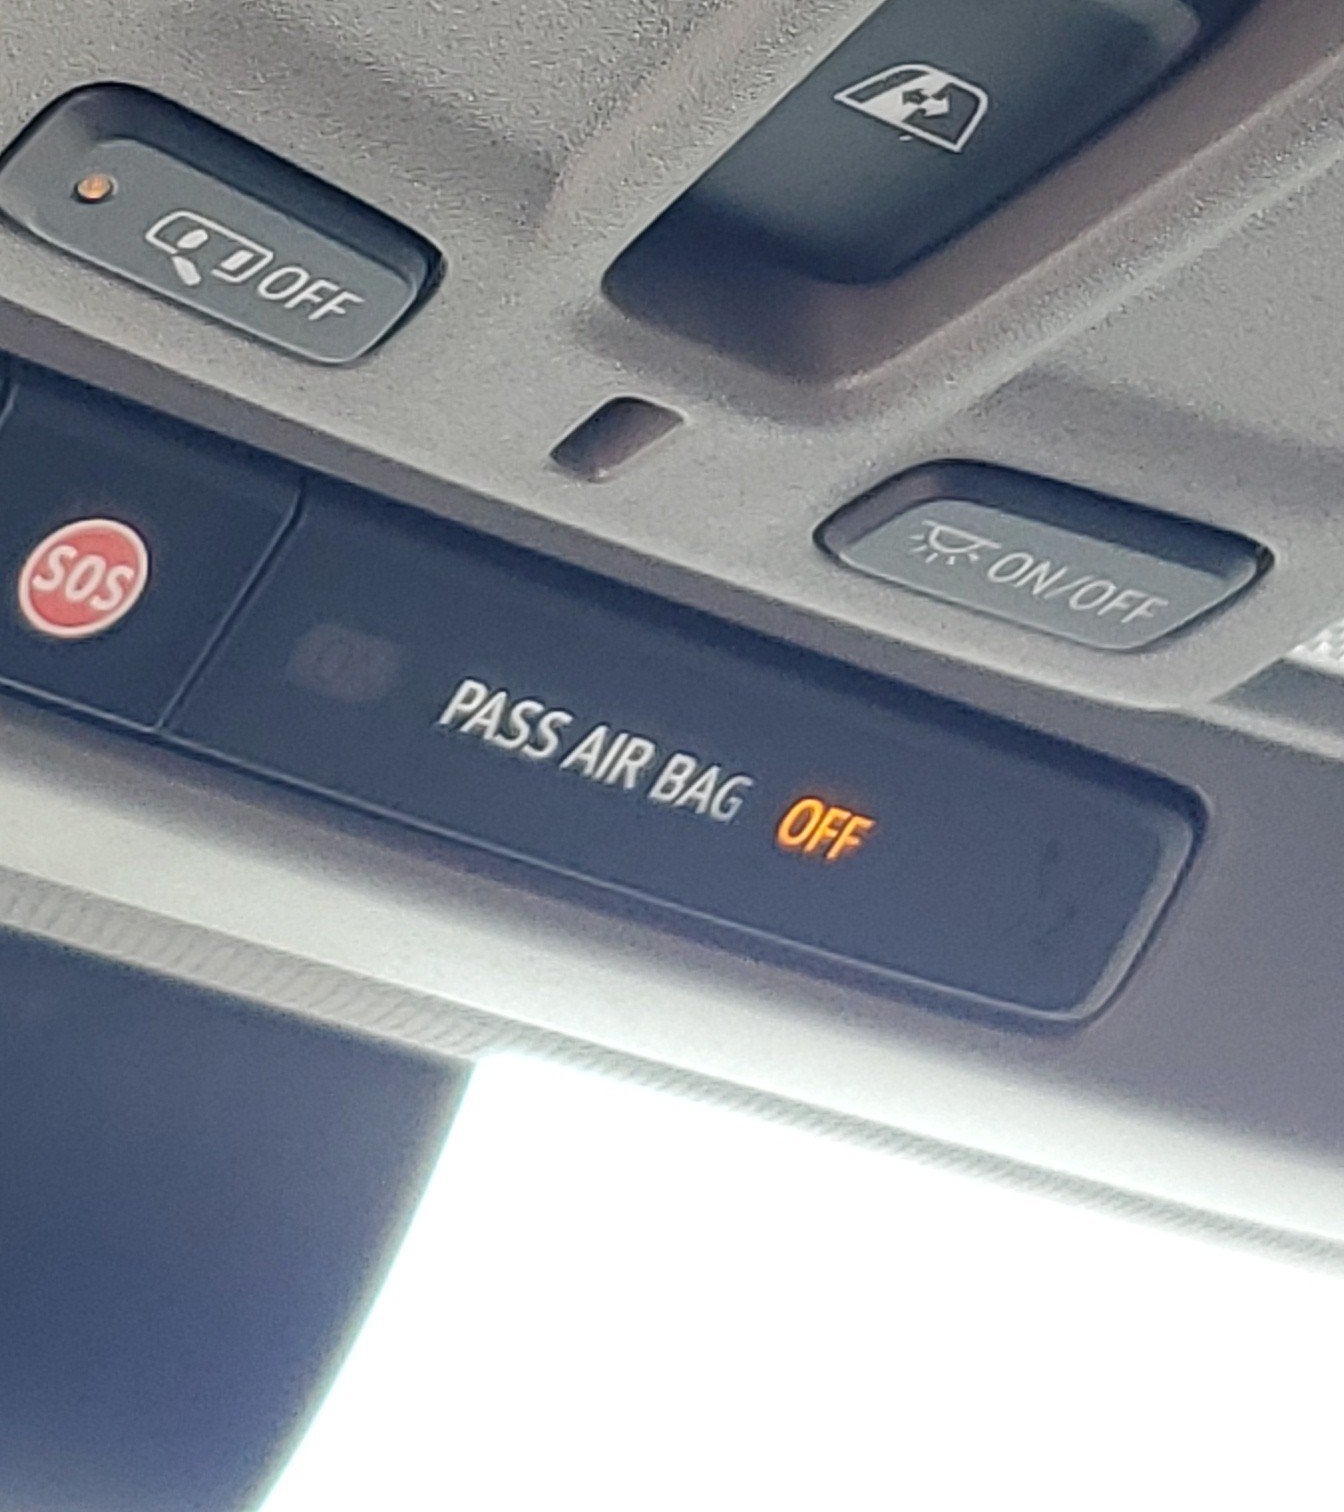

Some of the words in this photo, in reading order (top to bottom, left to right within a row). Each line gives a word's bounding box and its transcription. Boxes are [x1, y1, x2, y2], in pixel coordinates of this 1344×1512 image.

[258, 266, 363, 320] OFF
[32, 544, 134, 610] SOS
[987, 552, 1169, 623] ON/OFF
[438, 679, 573, 759] PASS
[560, 725, 657, 789] AIR
[649, 752, 754, 822] BAG
[776, 798, 876, 860] OFF
